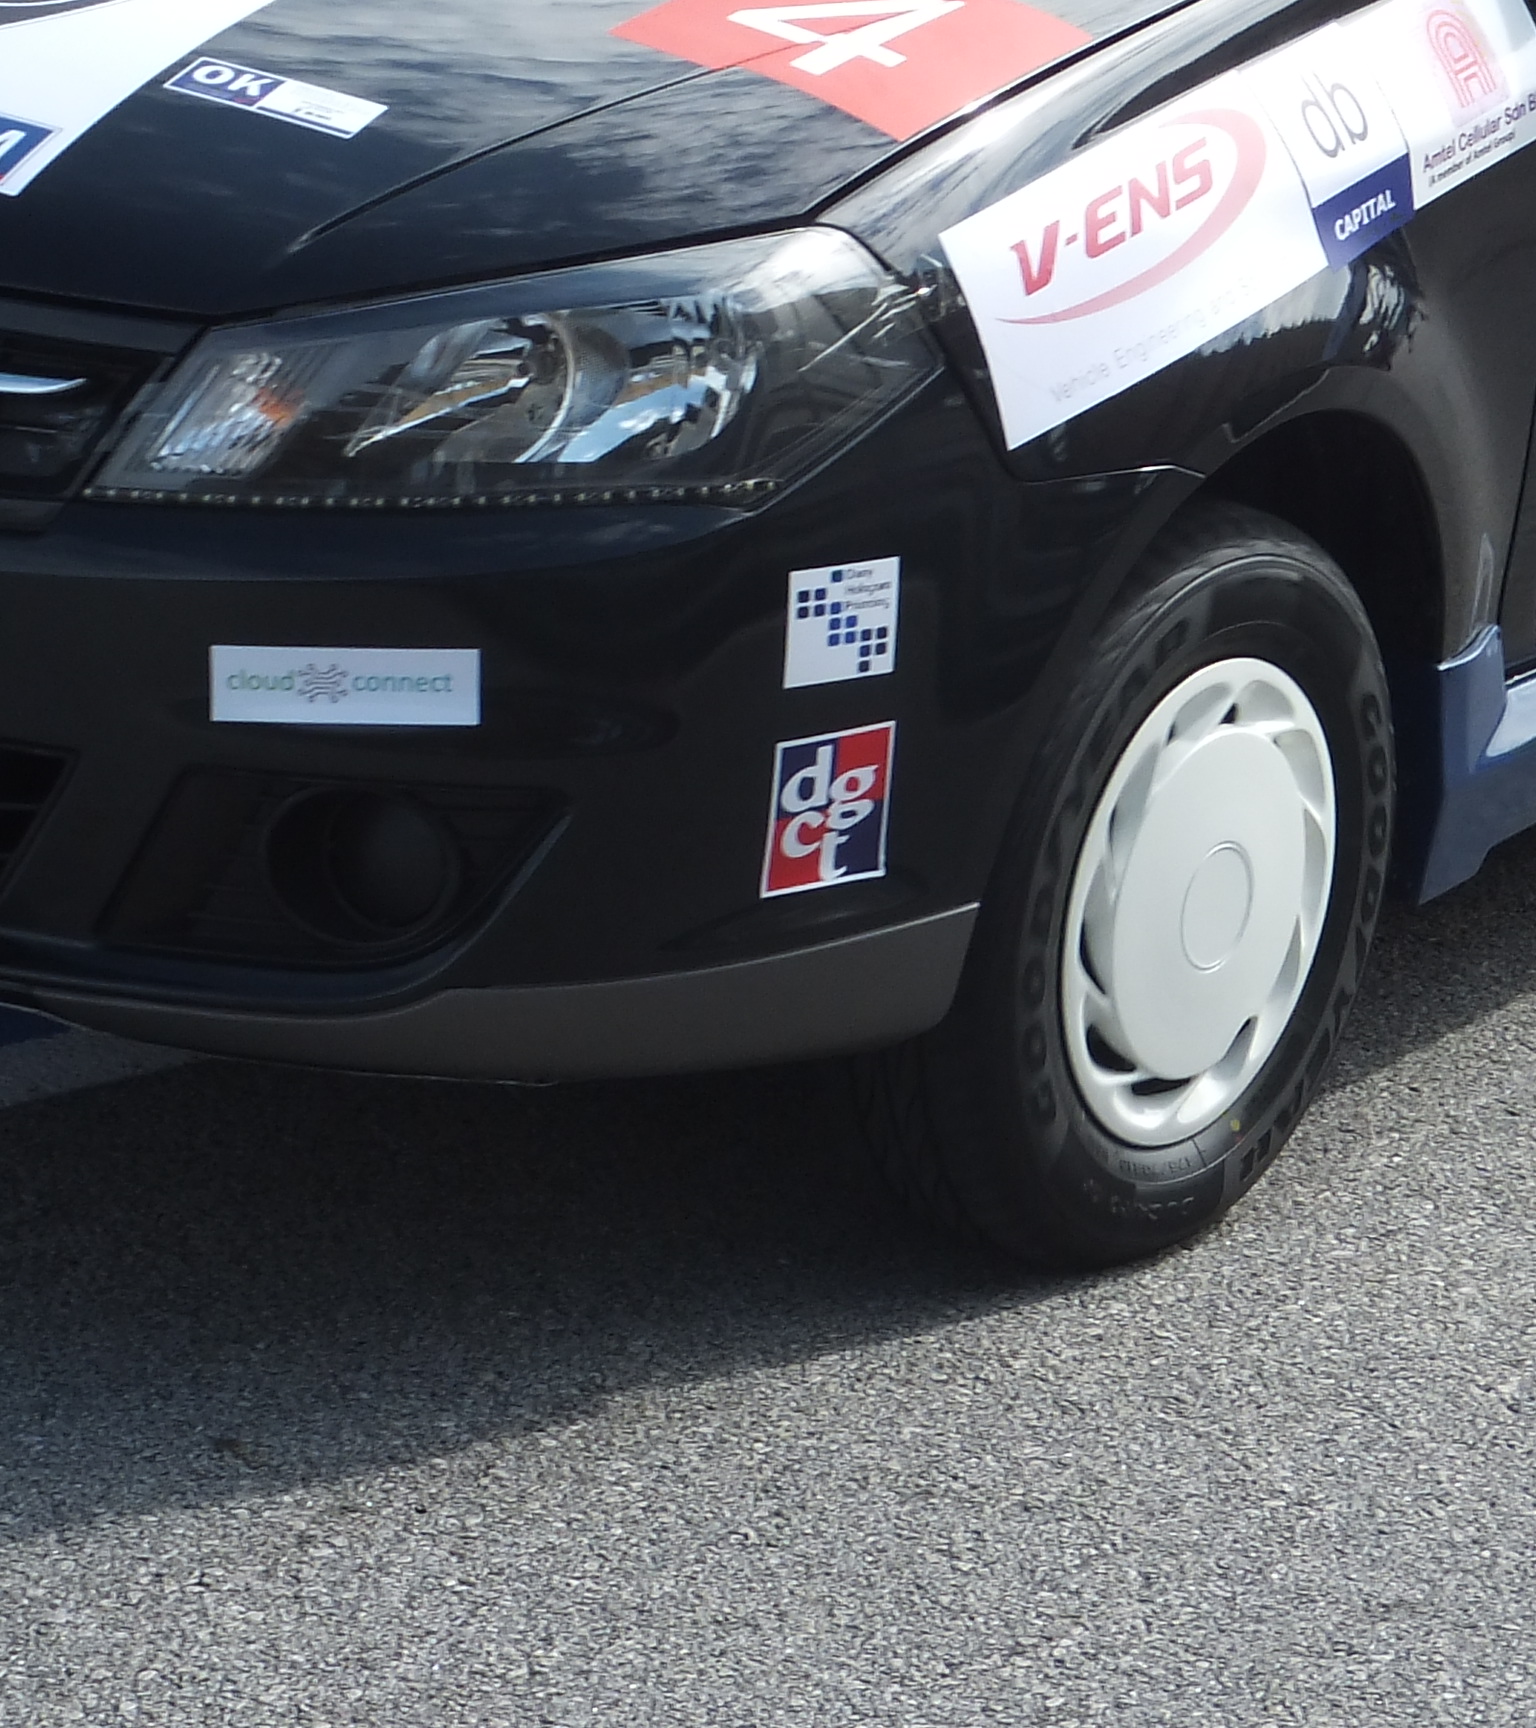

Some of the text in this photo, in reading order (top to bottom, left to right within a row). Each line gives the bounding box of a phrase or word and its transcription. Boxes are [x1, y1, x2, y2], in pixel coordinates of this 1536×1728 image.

[193, 65, 275, 96] OK
[1300, 72, 1368, 159] db
[1423, 139, 1457, 173] Amtel
[1458, 114, 1503, 151] Cellular
[1504, 102, 1526, 125] Sdn
[1010, 138, 1213, 296] V-ENS
[1334, 189, 1397, 241] CAPITAL
[226, 667, 454, 695] cloud connect
